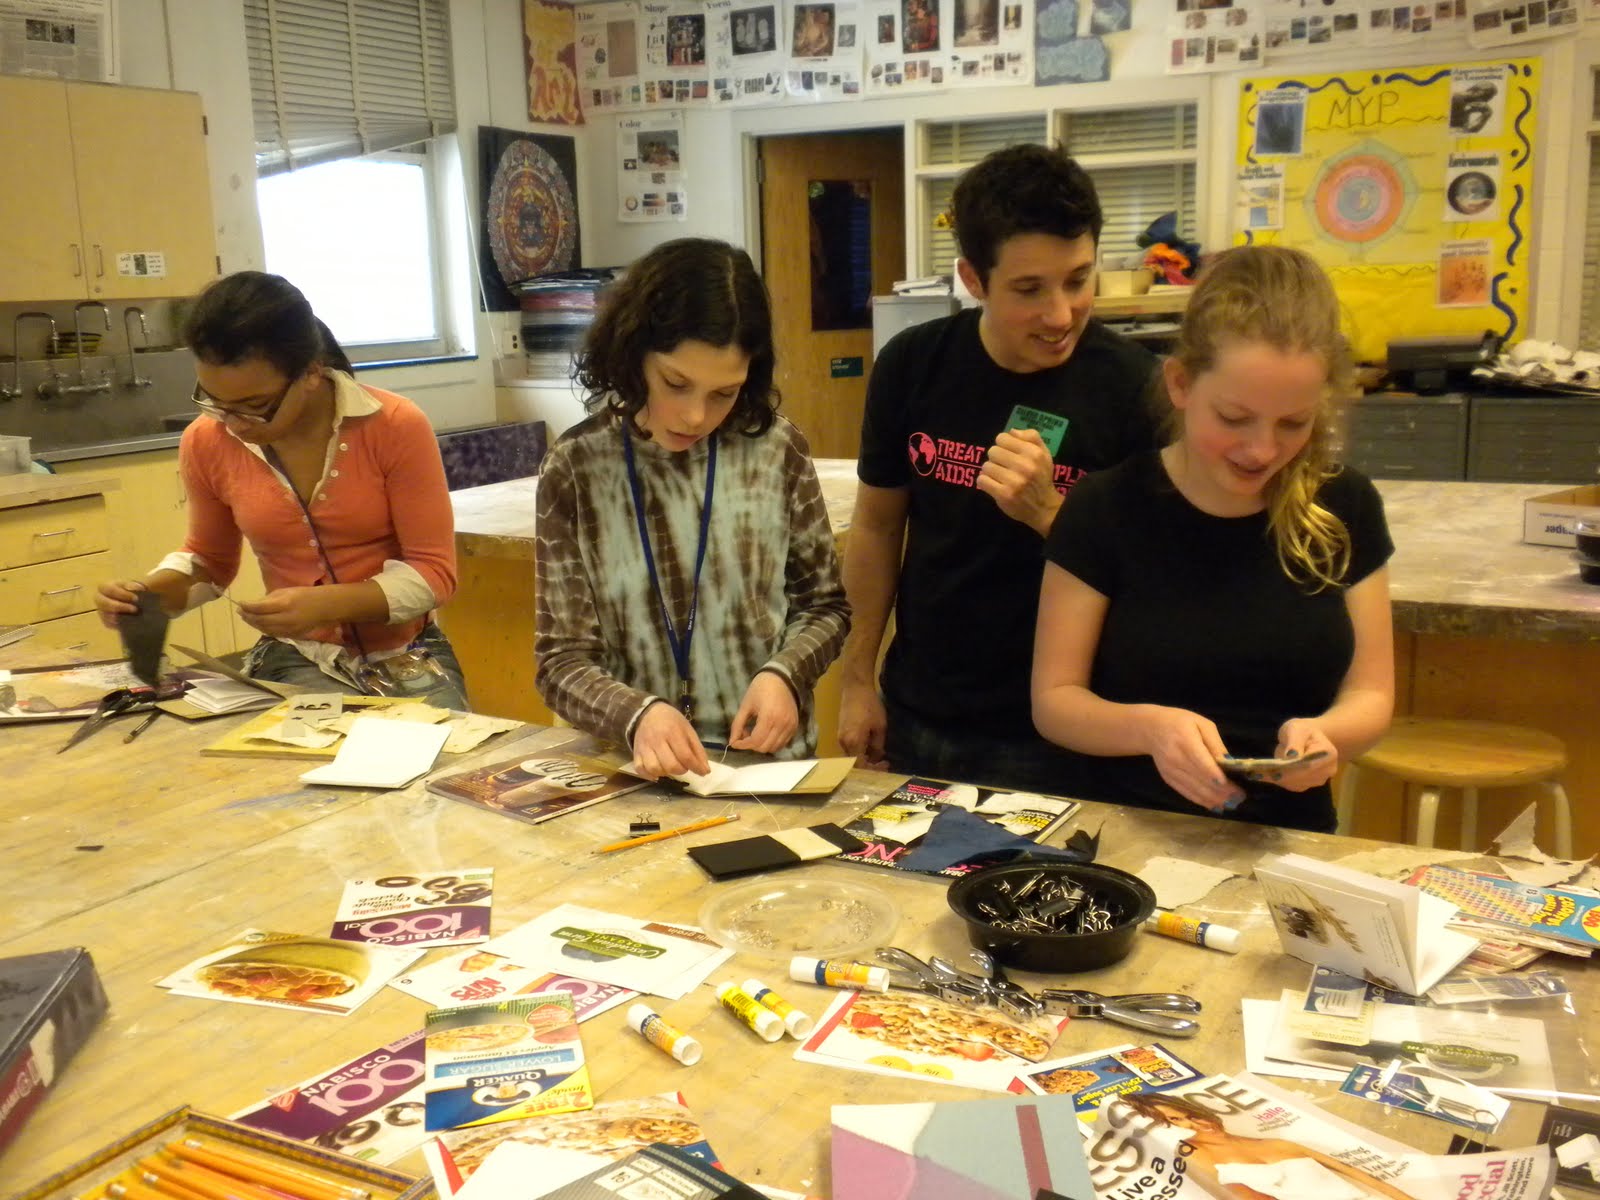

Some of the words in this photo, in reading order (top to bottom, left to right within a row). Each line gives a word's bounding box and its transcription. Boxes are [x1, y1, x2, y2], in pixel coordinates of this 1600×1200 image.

[1328, 91, 1399, 127] MYP
[619, 119, 642, 129] Color
[937, 438, 986, 464] TREAT
[935, 462, 975, 488] AIDS
[359, 912, 462, 938] 100
[366, 931, 456, 945] NABISCO
[593, 938, 660, 958] Cascadian
[449, 1062, 503, 1075] SUGAR
[506, 1054, 562, 1071] LOWER
[301, 1054, 391, 1098] NABISCO
[473, 1071, 542, 1087] QUAKER
[569, 1091, 590, 1108] 2
[1253, 1106, 1286, 1122] Halle
[1151, 1156, 1166, 1175] a
[1525, 1157, 1535, 1179] more
